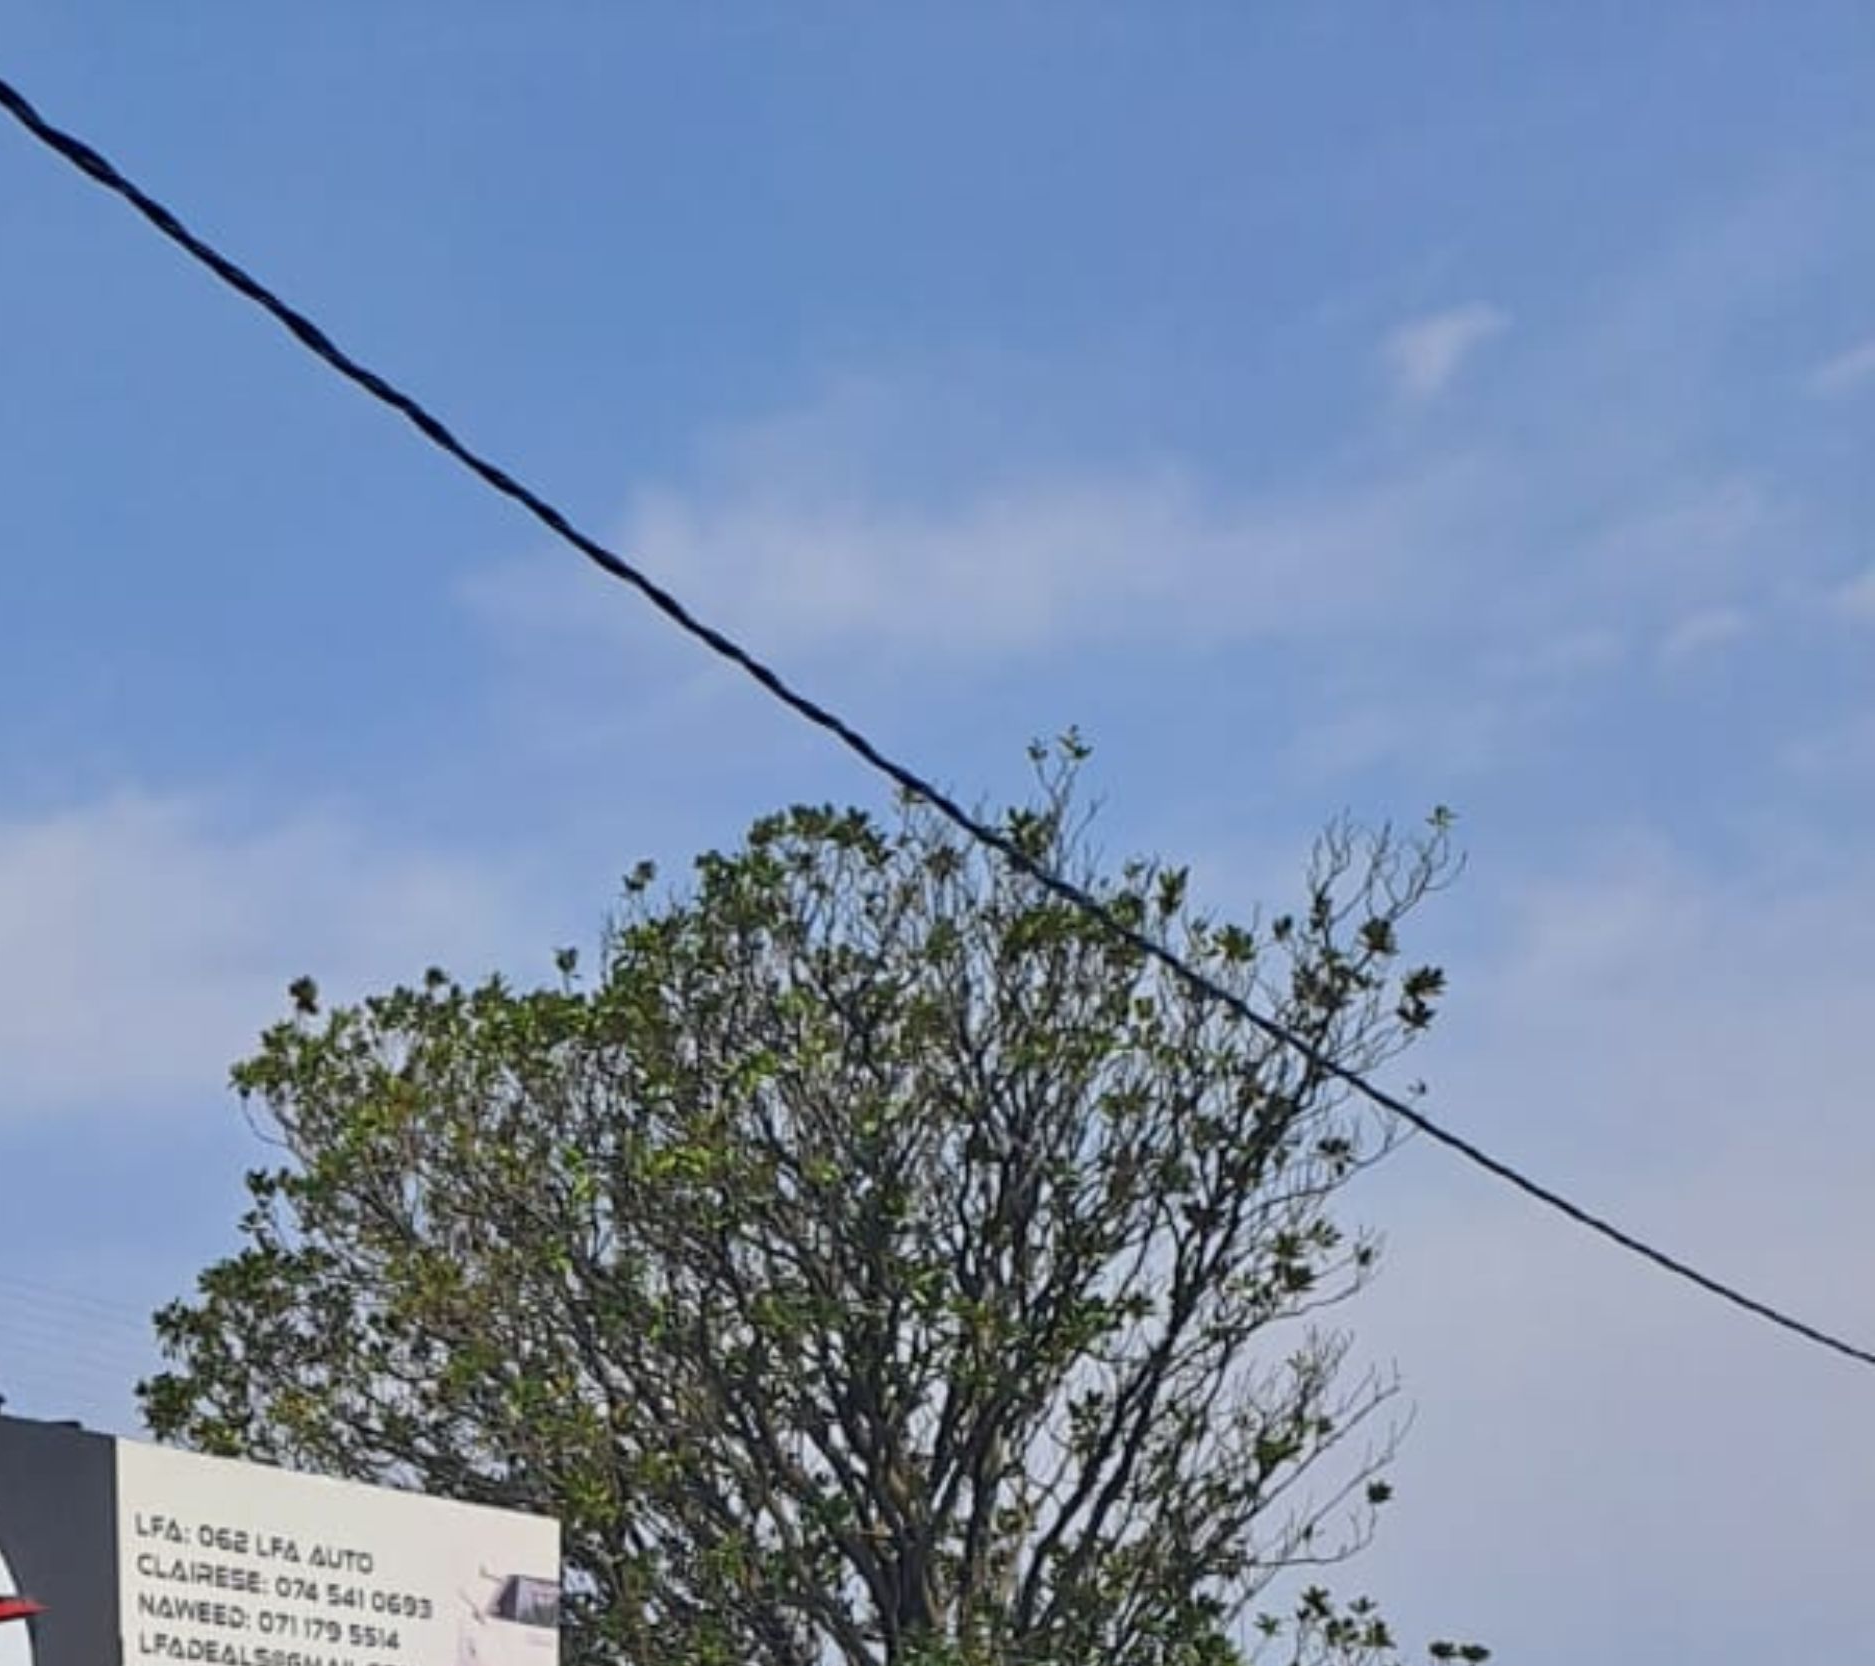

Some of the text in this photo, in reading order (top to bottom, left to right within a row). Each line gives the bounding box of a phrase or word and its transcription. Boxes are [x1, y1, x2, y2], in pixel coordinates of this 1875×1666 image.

[134, 1512, 374, 1575] LFA: 062 LFA AUTO
[136, 1552, 433, 1620] CLAIRESE: 074 541 0693
[137, 1591, 251, 1630] NAWEED:
[258, 1610, 299, 1637] 071
[303, 1617, 342, 1643] 179
